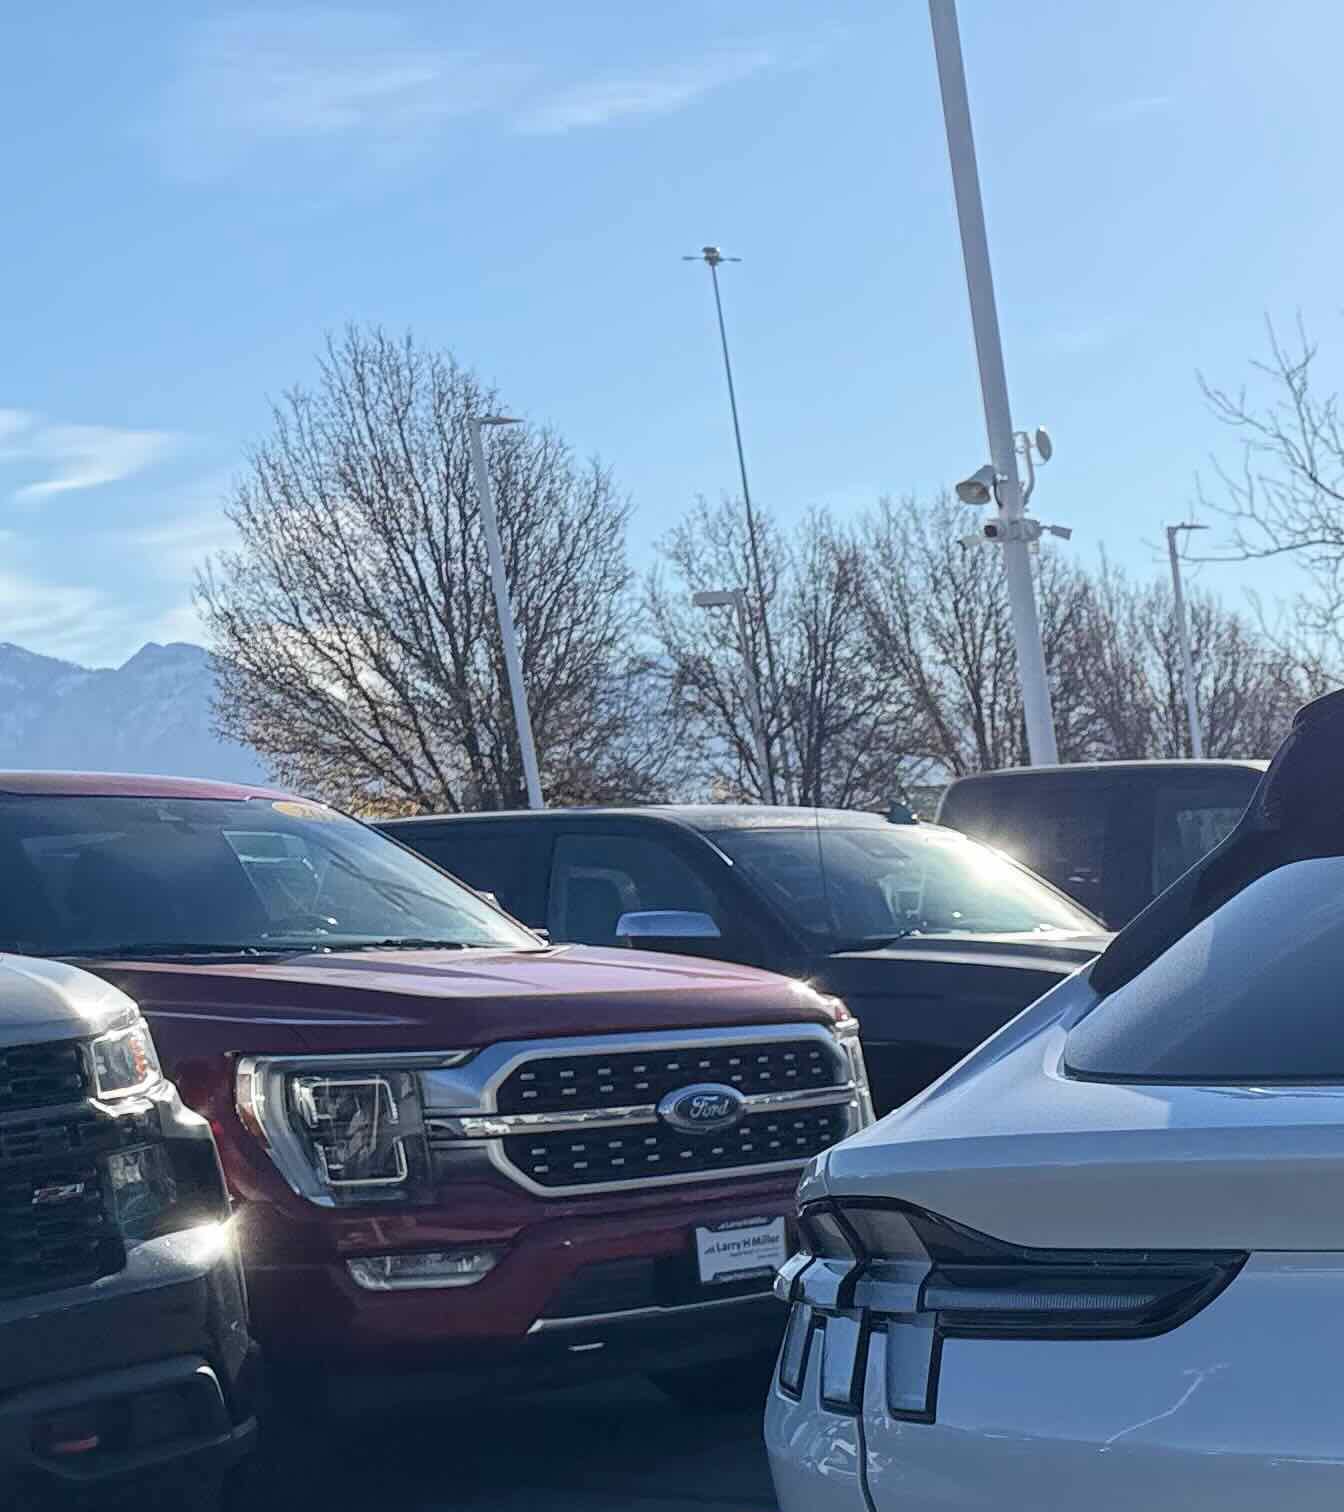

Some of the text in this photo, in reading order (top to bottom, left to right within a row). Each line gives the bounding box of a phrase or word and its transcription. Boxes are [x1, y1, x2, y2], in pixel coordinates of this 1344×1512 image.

[689, 1095, 729, 1118] Ford
[716, 1240, 741, 1254] Larry
[743, 1237, 751, 1248] H
[752, 1234, 780, 1246] Miller
